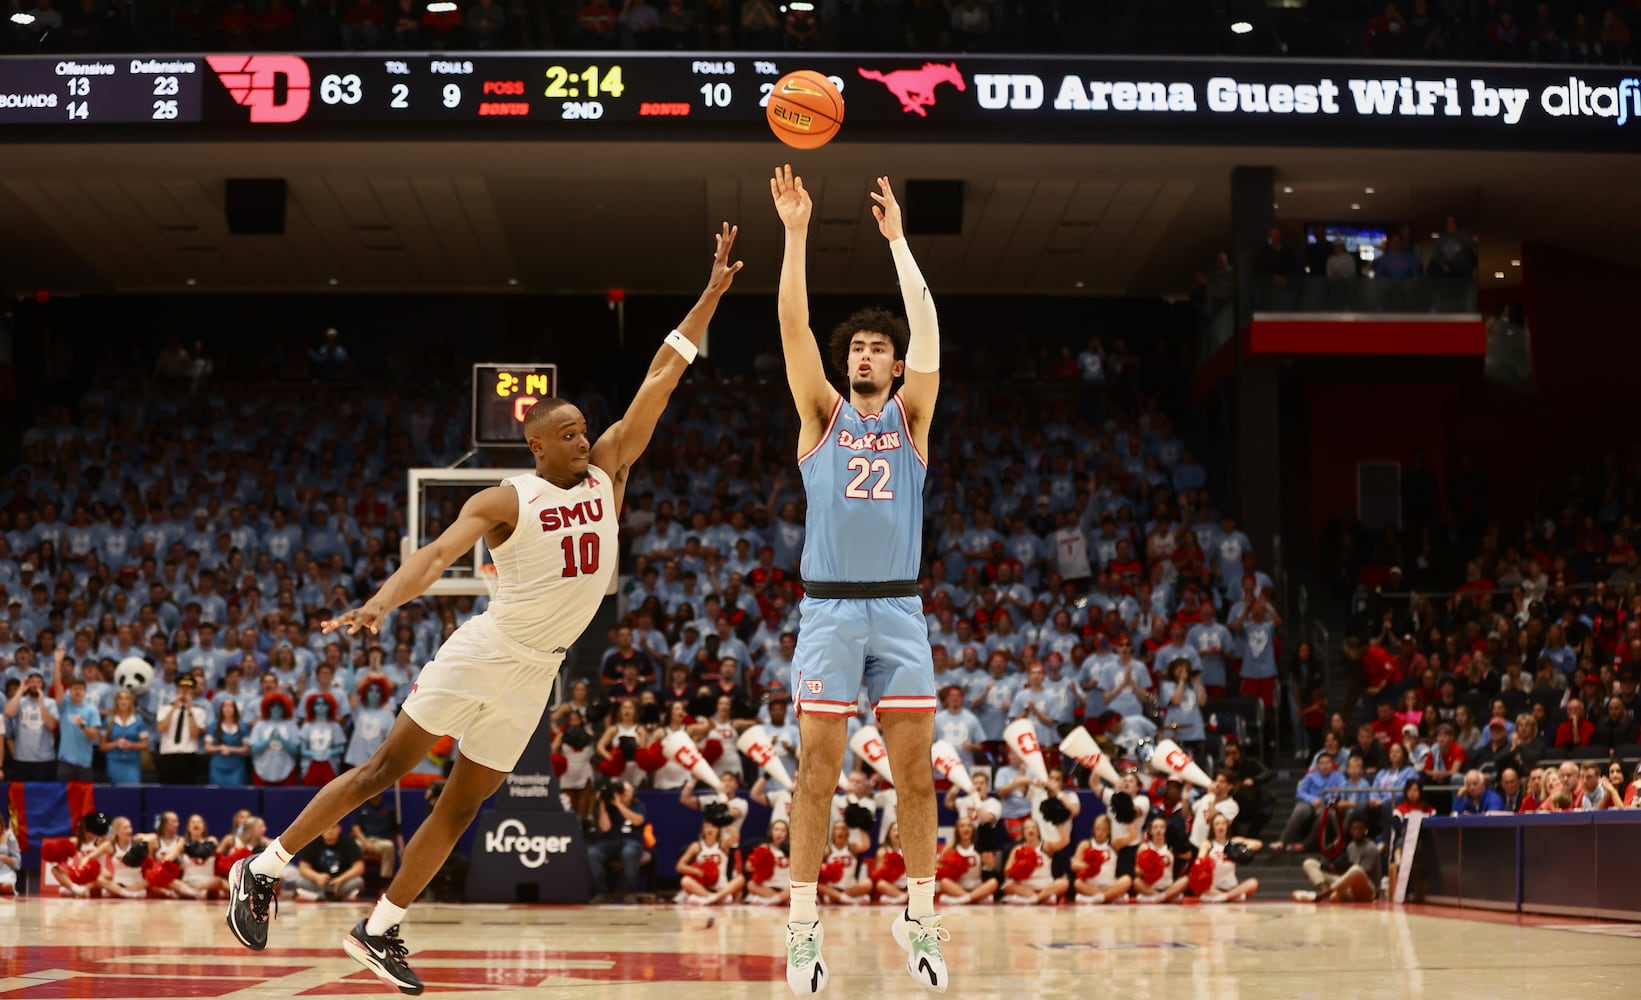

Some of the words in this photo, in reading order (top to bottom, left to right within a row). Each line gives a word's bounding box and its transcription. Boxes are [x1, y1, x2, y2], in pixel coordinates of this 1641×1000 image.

[55, 61, 115, 76] Offensive
[130, 59, 196, 74] Defensive
[384, 61, 410, 75] TOL
[431, 60, 474, 75] FOULS
[692, 60, 736, 75] FOULS
[753, 61, 779, 75] TOL
[66, 77, 91, 96] 13
[153, 75, 179, 96] 23
[319, 73, 363, 105] 63
[483, 80, 525, 95] POSS
[544, 65, 625, 98] 2:14
[390, 83, 409, 108] 2
[442, 83, 462, 108] 9
[700, 82, 732, 107] 10
[973, 74, 1044, 110] UD
[1053, 75, 1197, 112] Arena
[1207, 77, 1340, 113] Guest
[1348, 76, 1462, 116] WiFi
[1470, 78, 1530, 125] by
[65, 100, 90, 120] 14
[152, 99, 179, 120] 25
[478, 102, 530, 116] BONUS
[561, 101, 604, 120] 2ND
[639, 102, 691, 116] BONUS
[774, 103, 812, 127] ELITE
[496, 372, 548, 397] 2:14
[845, 455, 895, 500] 22
[539, 498, 604, 533] SMU
[561, 532, 600, 578] 10
[485, 819, 573, 868] Kroger
